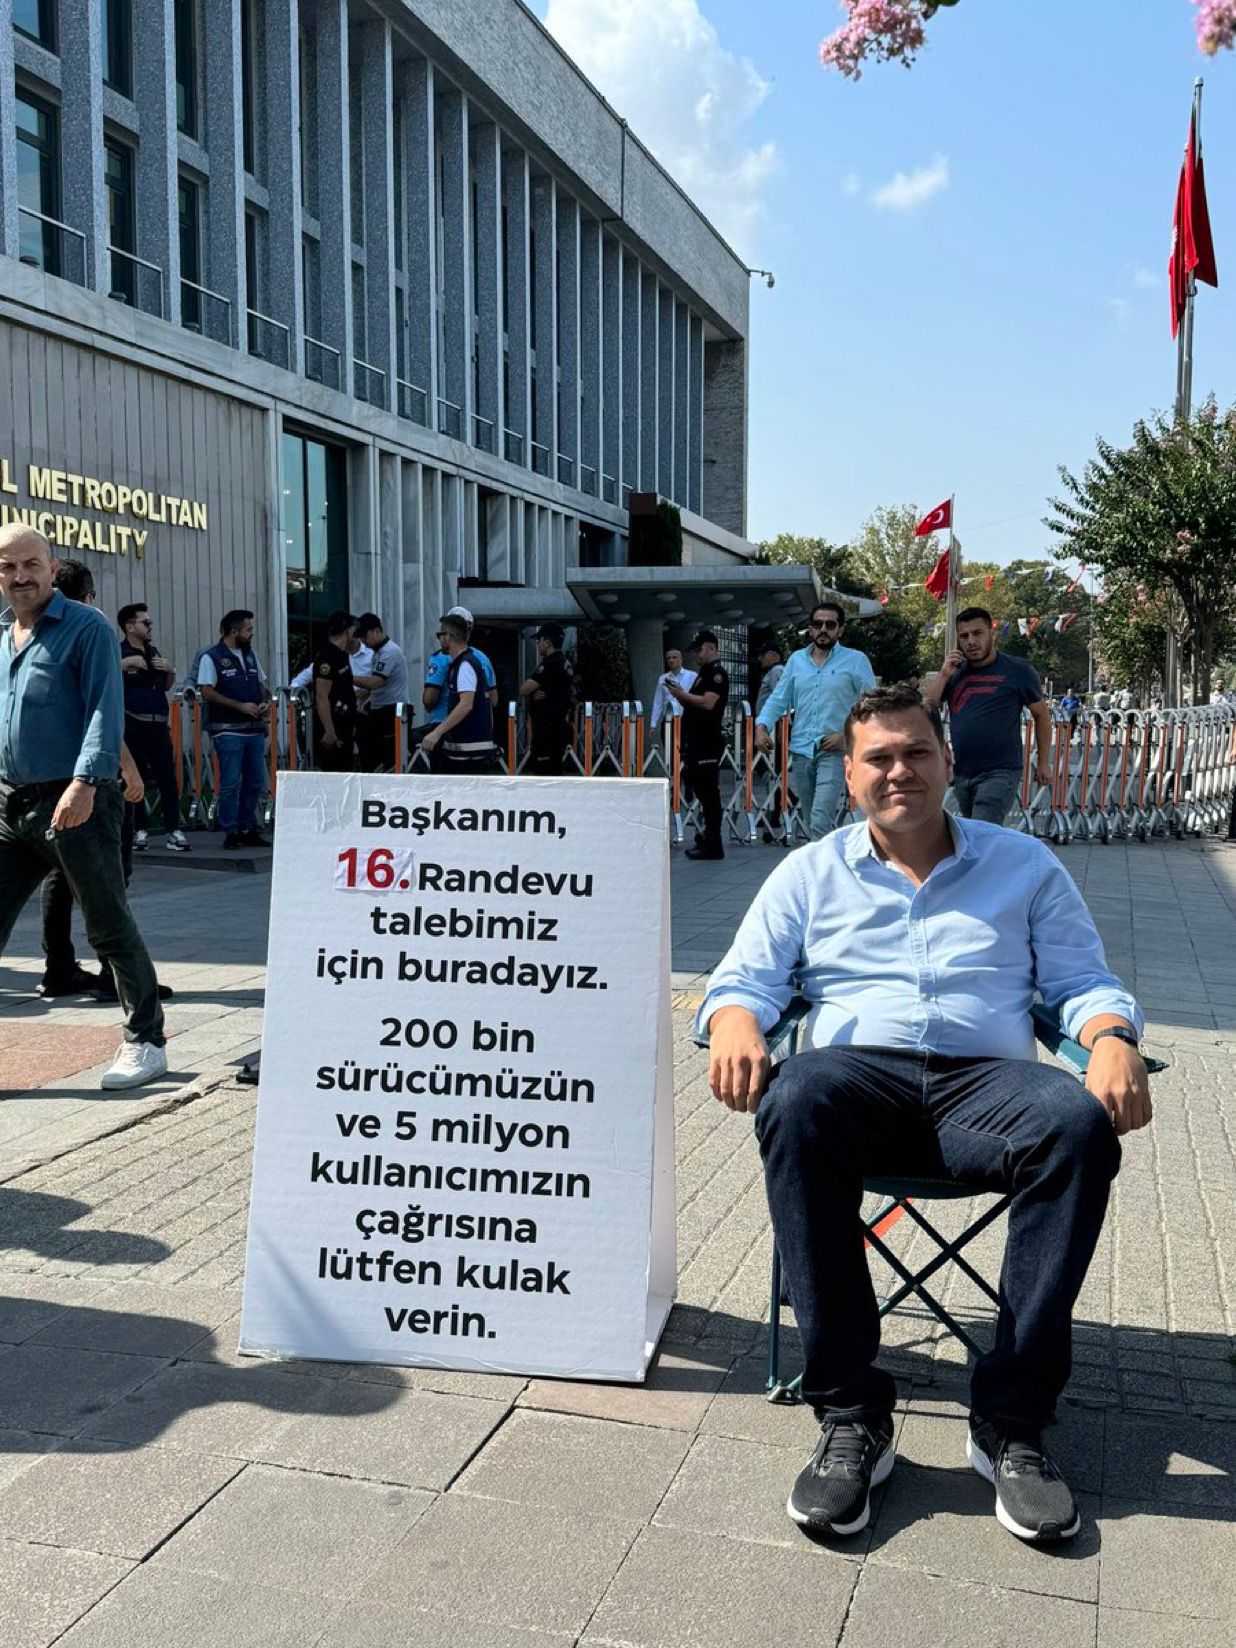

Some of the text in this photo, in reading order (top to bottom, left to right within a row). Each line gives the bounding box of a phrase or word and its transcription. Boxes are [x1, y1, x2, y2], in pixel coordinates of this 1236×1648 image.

[28, 464, 208, 532] METROPOLITAN
[360, 799, 567, 839] Başkanım,
[338, 847, 593, 898] 16. Randevu
[370, 905, 558, 942] talebimiz
[316, 948, 608, 994] için buradayız.
[379, 1017, 535, 1053] 200 bin
[316, 1060, 595, 1104] sürücümüzün
[335, 1110, 570, 1153] ve 5 milyon
[310, 1151, 591, 1199] kullanıcımızın
[355, 1203, 538, 1244] çağrısına
[317, 1247, 572, 1295] lütfen kulak
[384, 1304, 497, 1340] verin.
